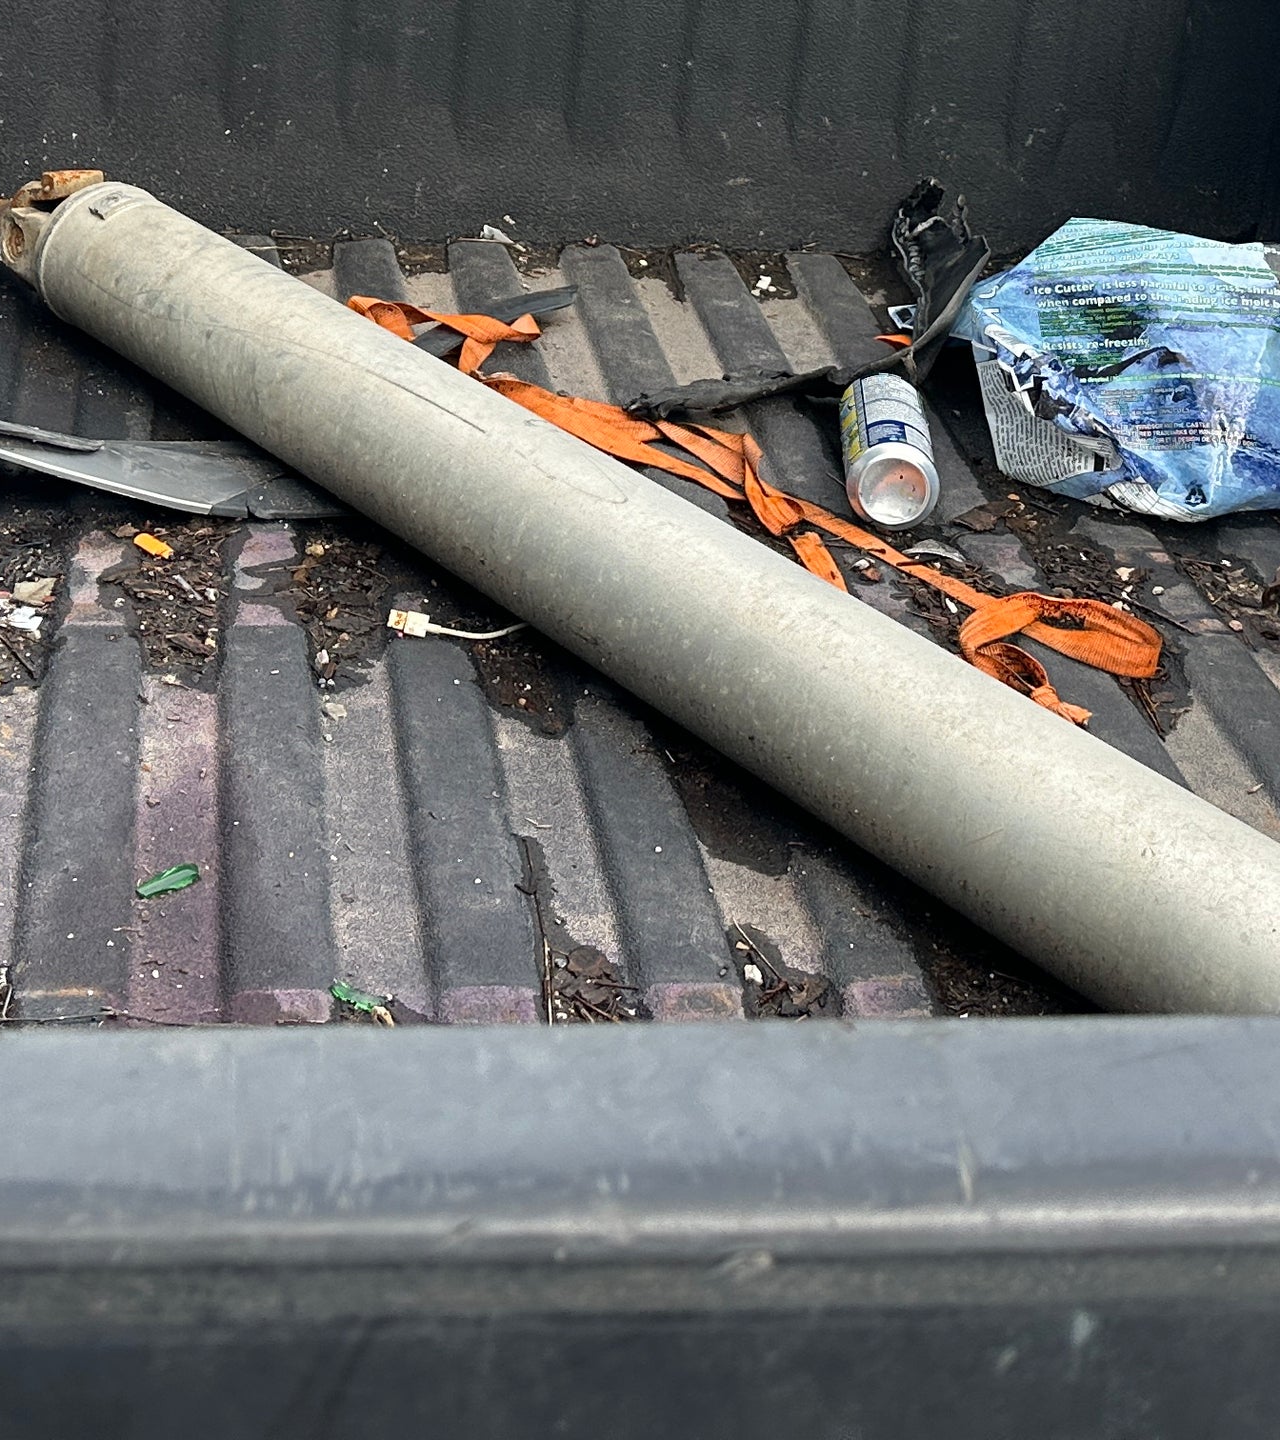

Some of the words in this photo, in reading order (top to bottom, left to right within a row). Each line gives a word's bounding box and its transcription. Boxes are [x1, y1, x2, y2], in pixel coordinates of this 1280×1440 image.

[1033, 285, 1052, 296] Ice
[1054, 283, 1095, 295] Cutter
[1102, 281, 1112, 291] is
[1114, 278, 1137, 290] less
[1140, 278, 1189, 292] harmful
[1192, 283, 1206, 293] to
[1037, 298, 1069, 309] when
[1072, 292, 1131, 307] compared
[1135, 292, 1147, 302] to
[1221, 297, 1238, 306] ice
[1086, 337, 1150, 349] re-freezing
